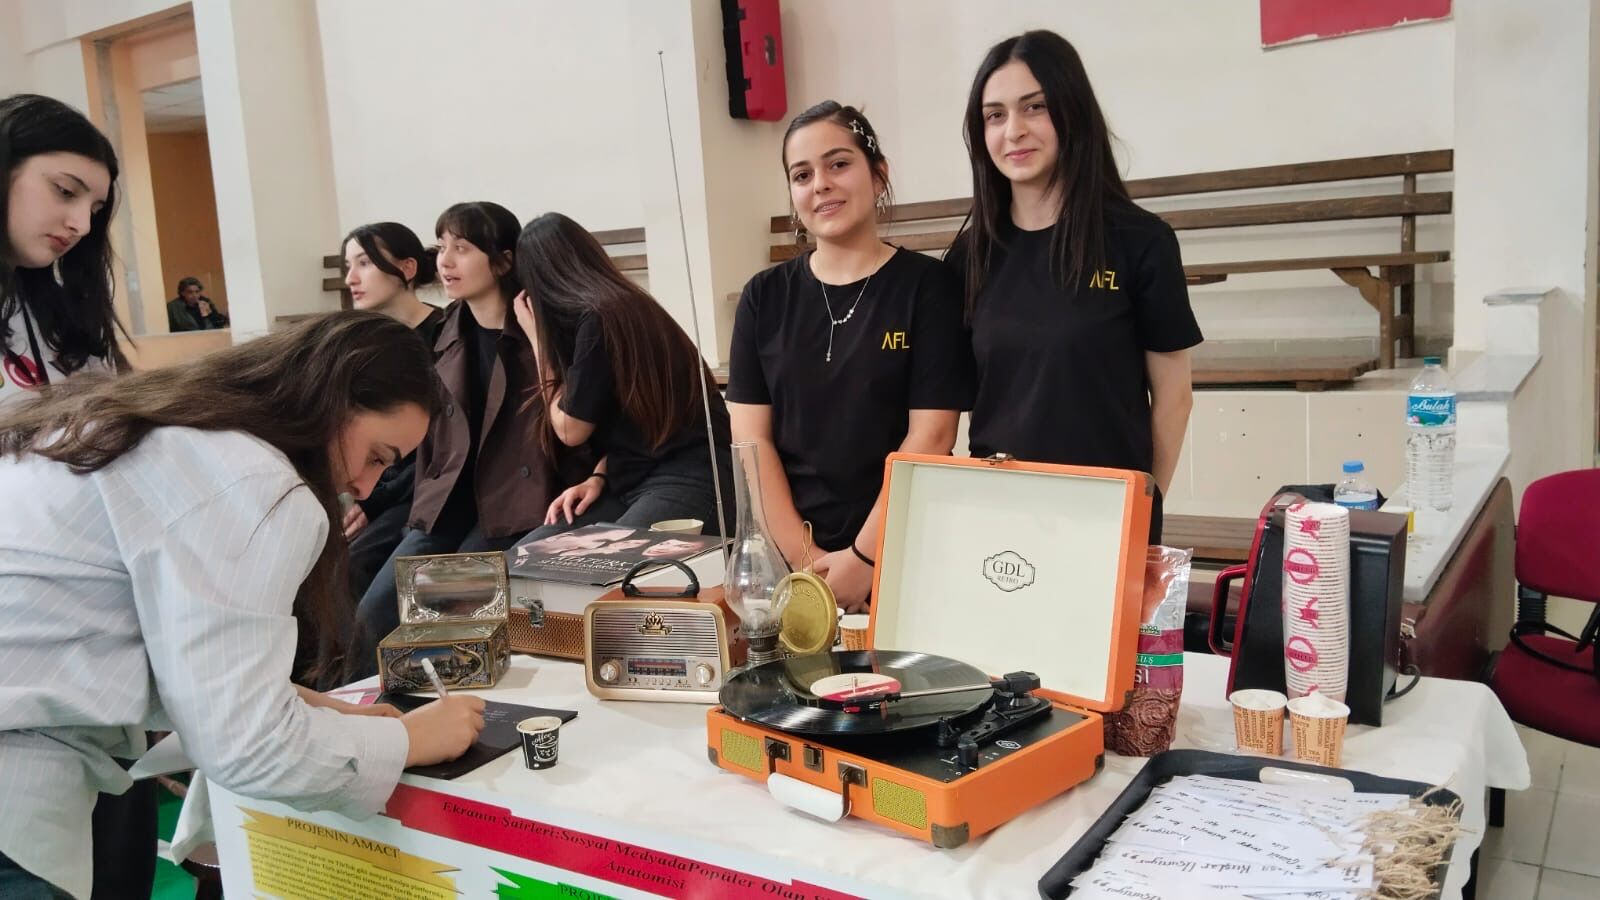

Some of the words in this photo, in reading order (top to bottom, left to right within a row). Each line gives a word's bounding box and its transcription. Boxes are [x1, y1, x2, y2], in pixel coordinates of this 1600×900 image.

[1089, 270, 1119, 290] AFL
[881, 331, 910, 350] AFL
[1412, 399, 1449, 412] Bulak
[993, 560, 1025, 577] GDL
[443, 802, 496, 823] Ekranın
[605, 860, 686, 890] Anatomisi
